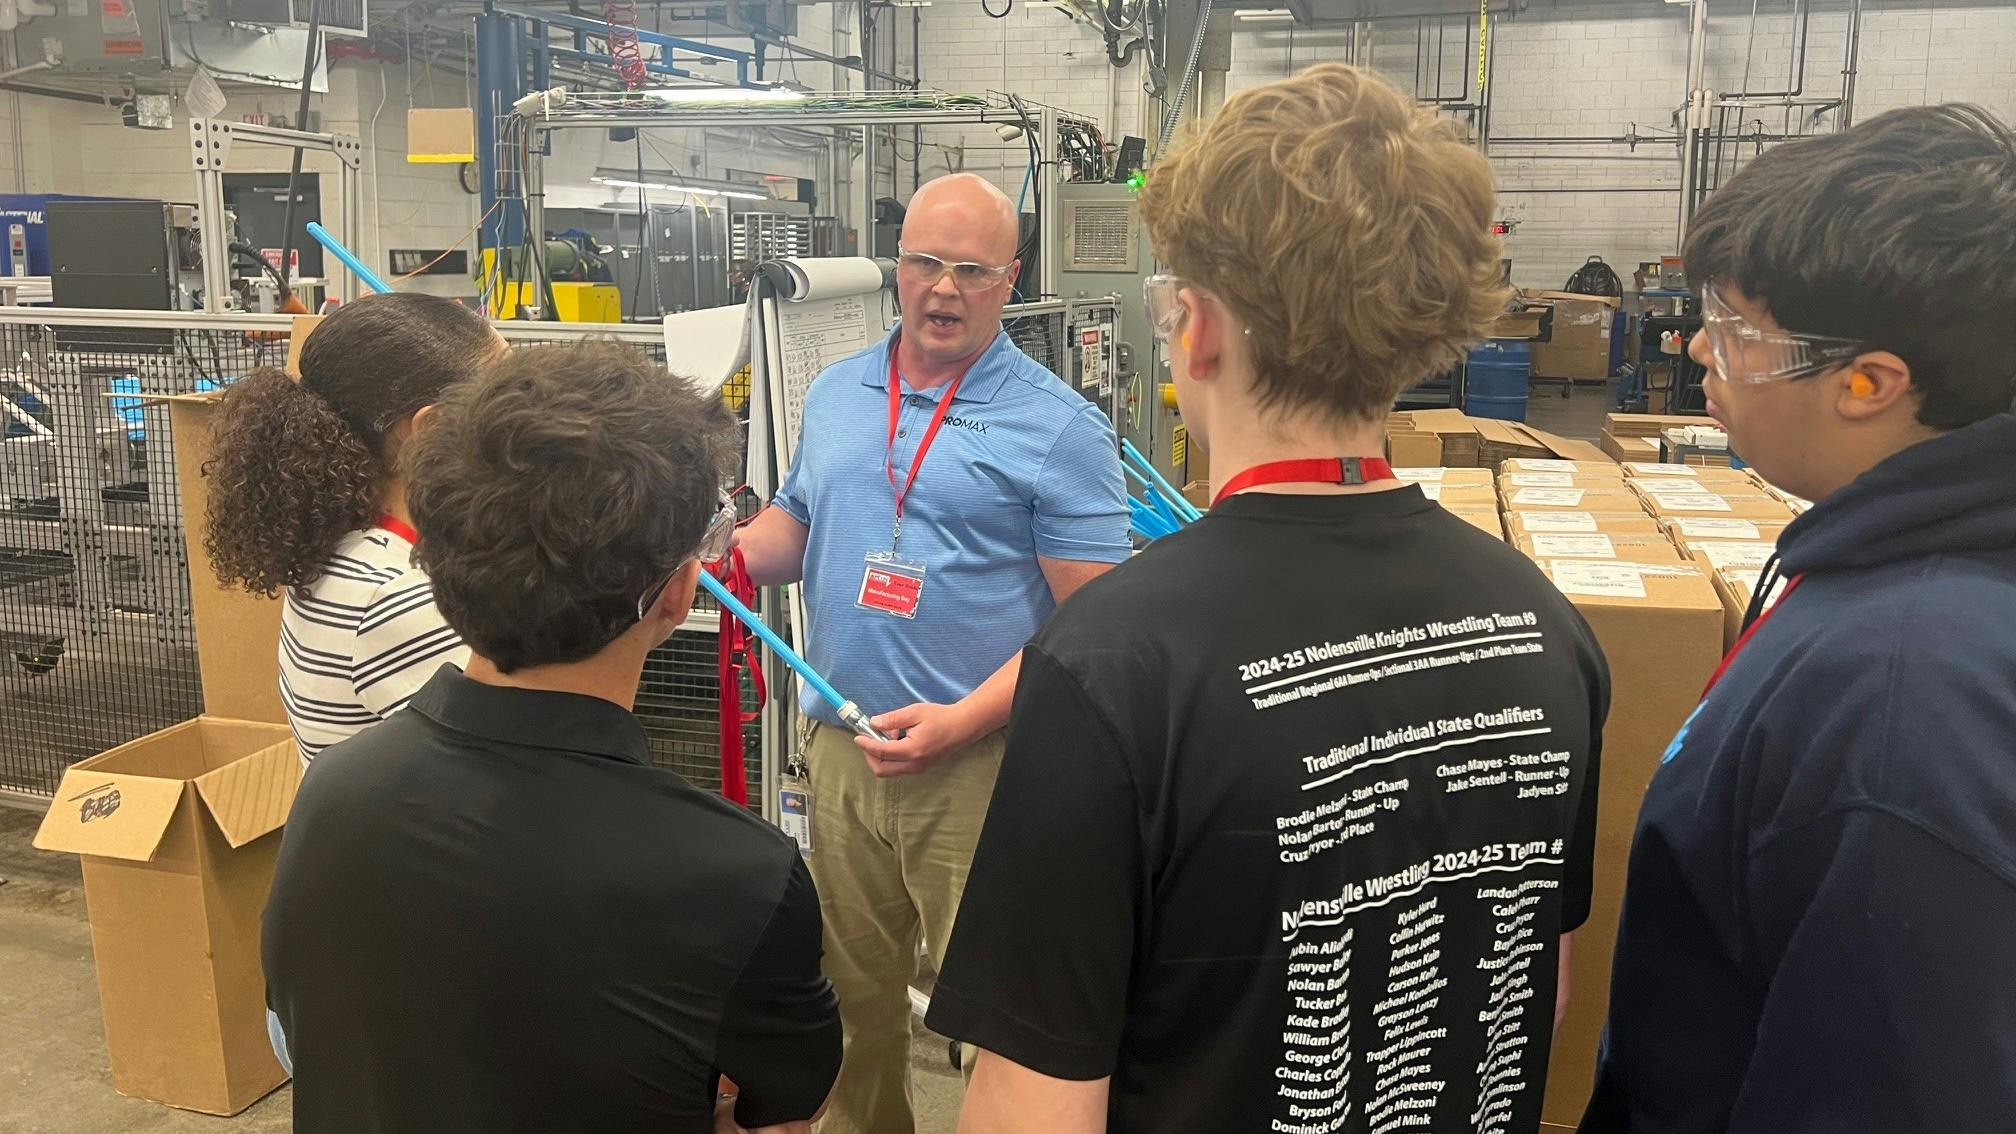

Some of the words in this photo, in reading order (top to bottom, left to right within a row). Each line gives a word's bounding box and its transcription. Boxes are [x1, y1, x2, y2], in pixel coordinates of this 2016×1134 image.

[1238, 650, 1306, 681] 2024-25
[1305, 634, 1376, 663] Nolensville
[1375, 627, 1427, 648] Knights
[1426, 616, 1495, 639] Wrestling
[1492, 613, 1523, 628] Team
[1523, 611, 1538, 626] #9
[1252, 687, 1301, 710] Traditional
[1300, 678, 1334, 697] Regional
[1334, 676, 1348, 687] 6AA
[1413, 658, 1429, 671] 3AA
[1428, 651, 1475, 668] Runner-Ups
[1479, 647, 1495, 659] 2nd
[1494, 645, 1513, 657] Place
[1511, 643, 1528, 655] Team
[1302, 736, 1368, 773] Traditional
[1371, 721, 1436, 751] Individual
[1437, 716, 1473, 736] State
[1473, 706, 1544, 729] Qualifiers
[1436, 764, 1467, 778] Chase
[1467, 758, 1503, 772] Mayes
[1509, 754, 1540, 765] State
[1541, 750, 1570, 763] Champ
[1446, 779, 1469, 793] Jake
[1469, 771, 1507, 787] Sentell
[1514, 770, 1554, 782] Runner
[1517, 785, 1554, 799] Jadyen
[1276, 810, 1316, 830] Brodie
[1352, 786, 1374, 802] State
[1374, 778, 1410, 794] Champ
[1278, 830, 1313, 846] Nolan
[1312, 817, 1345, 836] Barto
[1345, 803, 1376, 821] Runner
[1383, 798, 1400, 811] Up
[1280, 847, 1309, 863] Cruz
[1349, 822, 1375, 837] Place
[1282, 882, 1364, 931] Nlensvlle
[1432, 843, 1504, 872] 2024-25
[1550, 838, 1563, 855] #
[1477, 887, 1518, 899] Landon
[1391, 943, 1419, 961] Parker
[1287, 963, 1332, 976] Sawyer
[1388, 958, 1422, 977] Hudson
[1287, 978, 1325, 992] Nolan
[1387, 976, 1419, 993] Carson
[1294, 996, 1335, 1010] Tucker
[1373, 993, 1408, 1015] Michael
[1286, 1014, 1320, 1028] Kade
[1378, 1008, 1415, 1027] Grayson
[1283, 1032, 1330, 1046] William
[1384, 1025, 1405, 1041] Felix
[1285, 1050, 1331, 1067] George
[1275, 1067, 1322, 1082] Charles
[1399, 1064, 1432, 1079] Mayes
[1277, 1084, 1335, 1100] Jonathan
[1387, 1080, 1446, 1100] McSweeney
[1289, 1104, 1331, 1120] Bryson
[1402, 1113, 1432, 1127] Mink
[1271, 1119, 1330, 1134] Dominick
